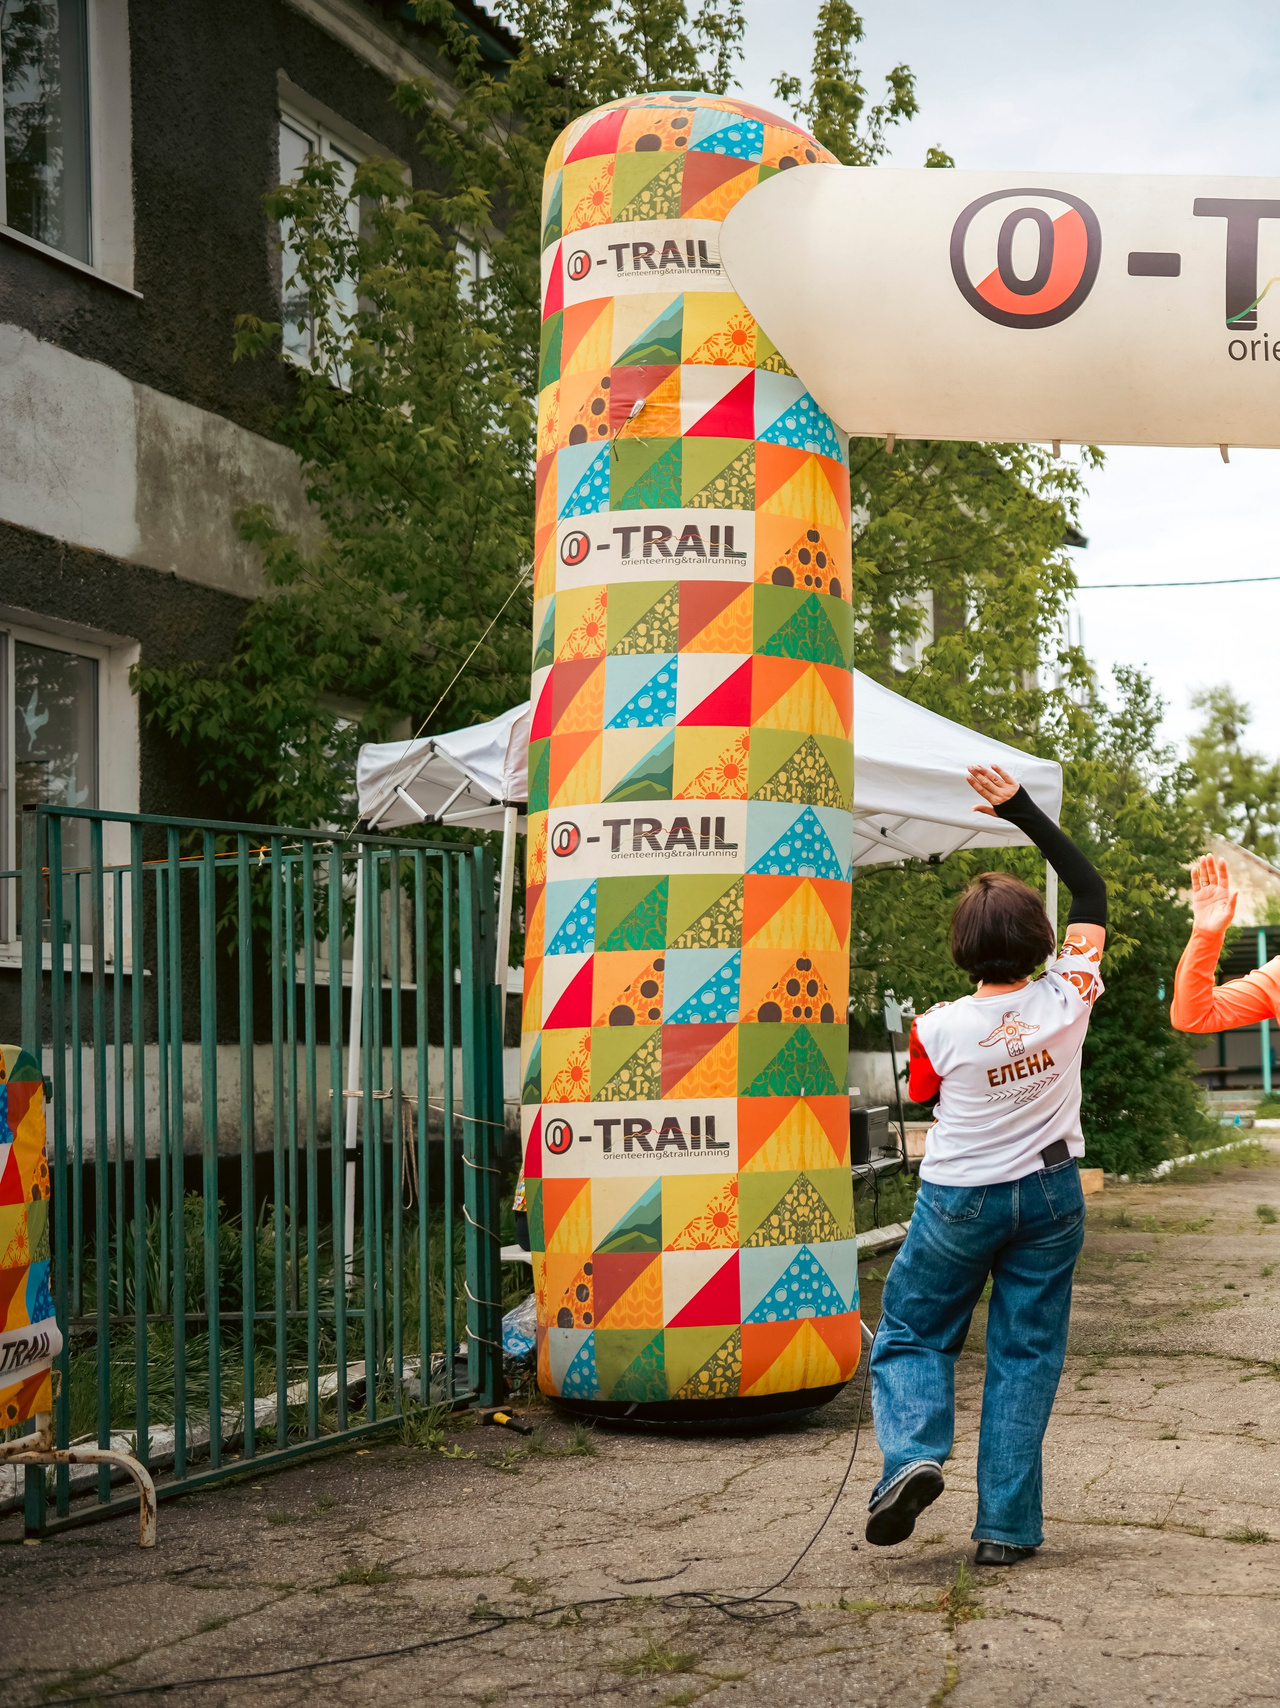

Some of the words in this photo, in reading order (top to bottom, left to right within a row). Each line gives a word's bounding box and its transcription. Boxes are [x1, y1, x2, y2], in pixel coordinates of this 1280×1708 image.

[617, 267, 721, 278] orienteering&trailrunning
[621, 556, 747, 567] orienteering&trailrunning
[611, 849, 738, 860] orienteering&trailrunning
[987, 1049, 1055, 1087] ЕЛЕНА
[603, 1149, 730, 1160] orienteering&trailrunning
